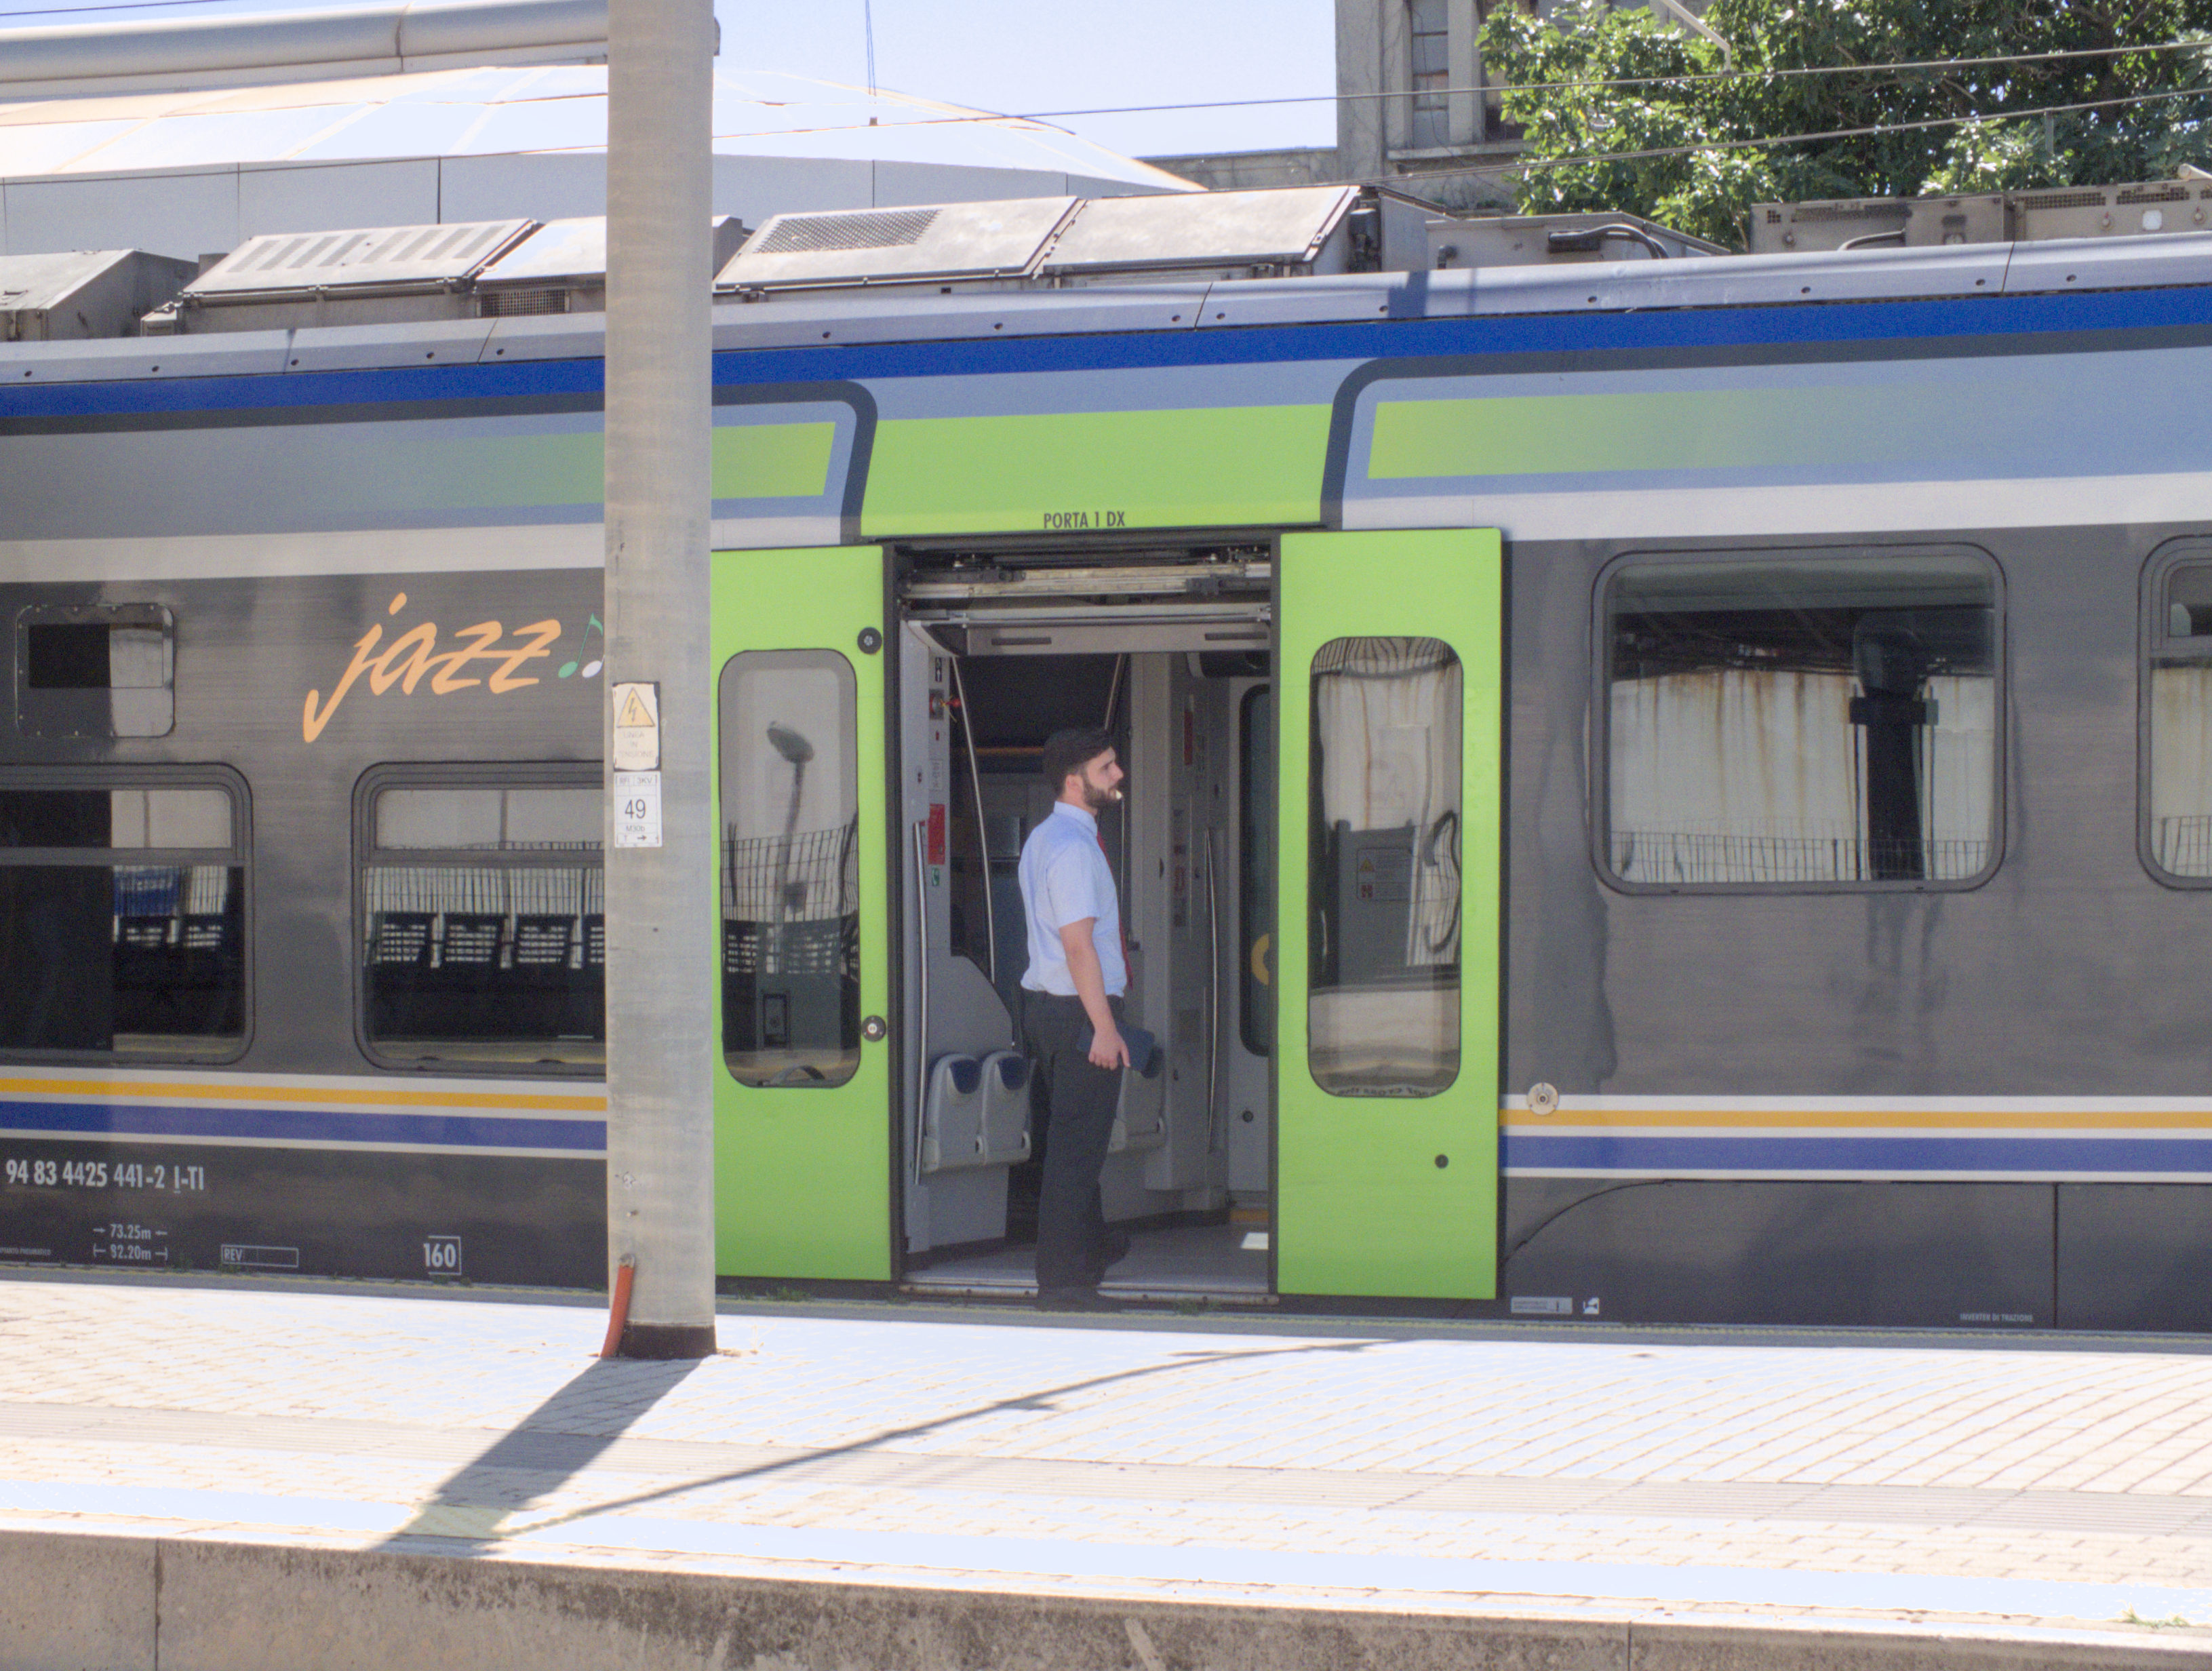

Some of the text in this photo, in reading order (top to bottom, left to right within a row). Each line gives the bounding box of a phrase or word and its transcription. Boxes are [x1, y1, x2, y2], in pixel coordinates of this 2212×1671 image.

[1044, 511, 1125, 529] PORTA 1 DX
[302, 591, 561, 743] jazz
[625, 799, 646, 819] 49
[6, 1159, 29, 1184] 94
[33, 1160, 57, 1186] 83
[62, 1160, 108, 1187] 4425
[113, 1163, 165, 1189] 441-2
[110, 1223, 151, 1240] 73.25m
[111, 1244, 151, 1261] 82.20m
[224, 1248, 243, 1261] REV
[423, 1242, 456, 1268] 160
